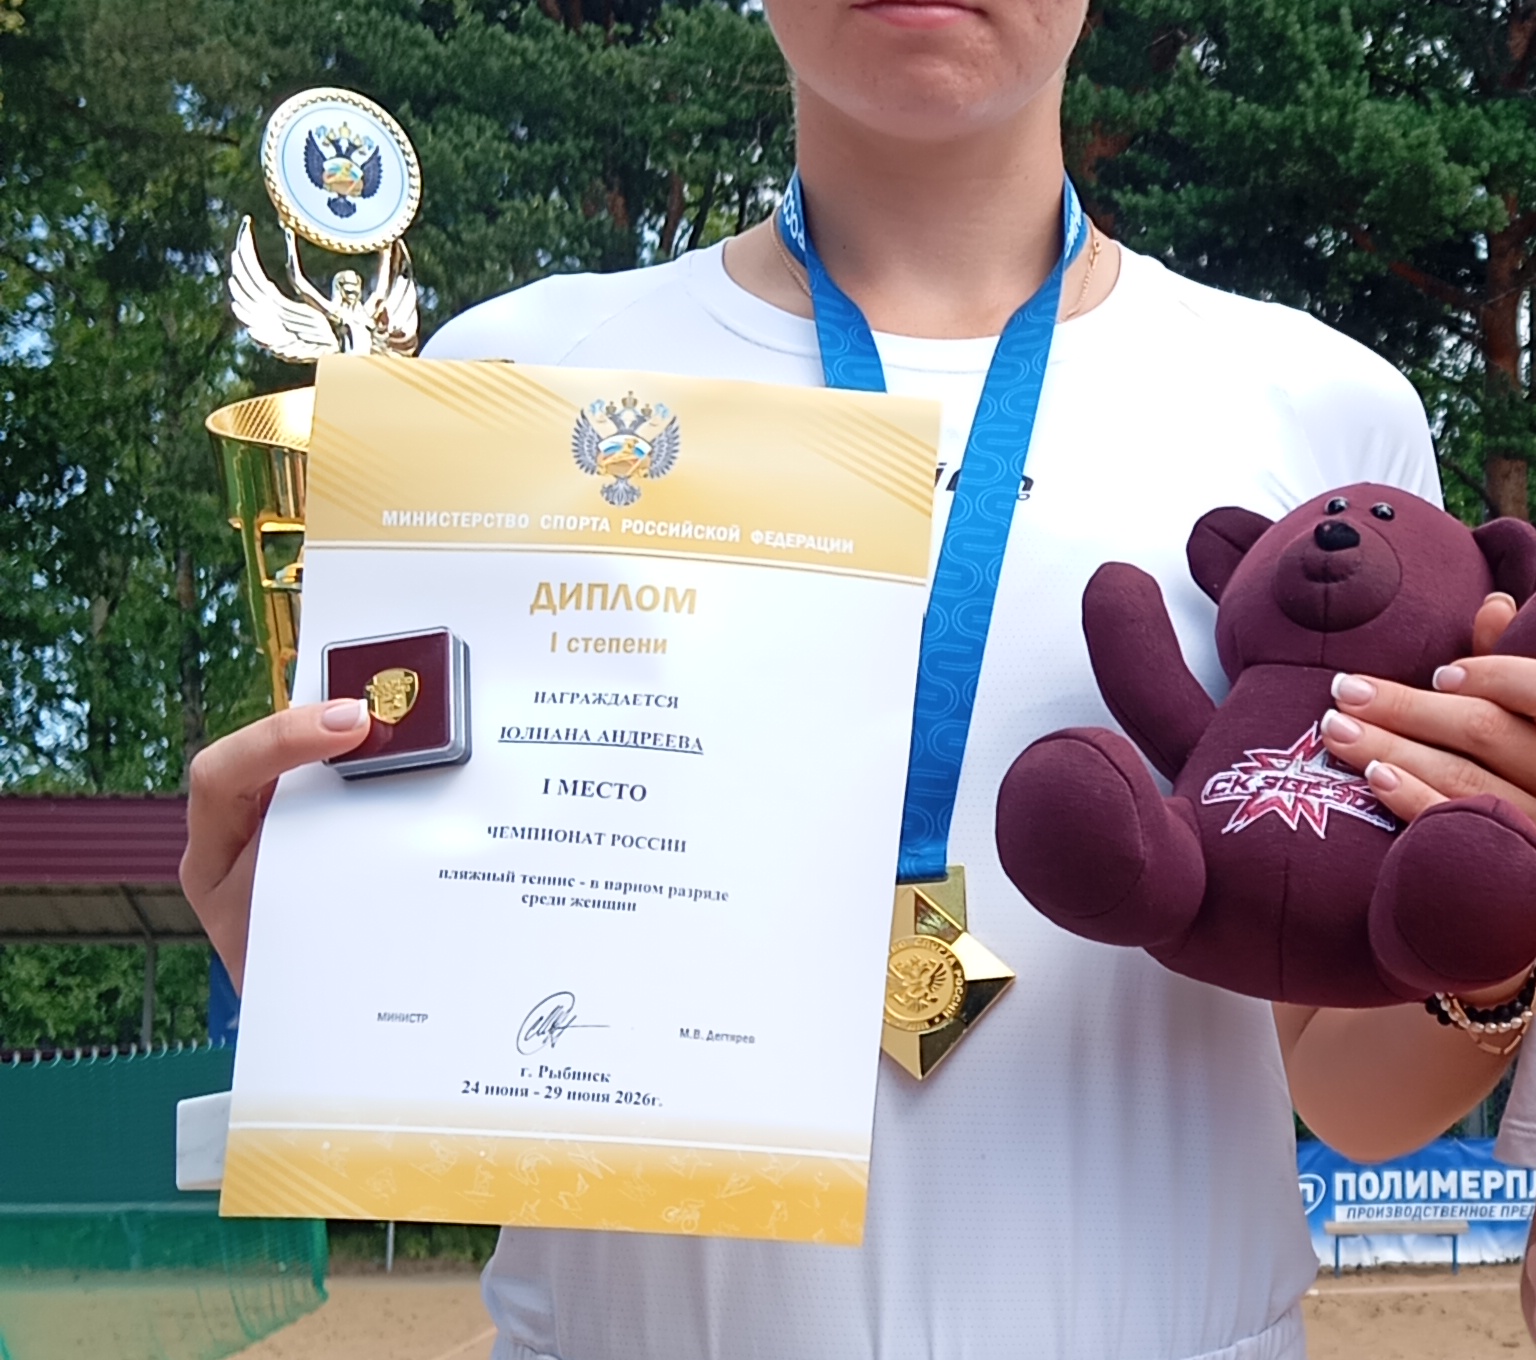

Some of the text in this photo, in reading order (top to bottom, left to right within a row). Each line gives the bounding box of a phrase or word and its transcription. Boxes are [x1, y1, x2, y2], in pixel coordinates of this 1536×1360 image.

[382, 509, 854, 554] МИНИСТЕРСТВО СПОРТА РОССИЙСКОЙ ФЕДЕРАЦИИ
[530, 581, 697, 616] ДИПЛОМ
[566, 636, 668, 654] степени
[533, 691, 679, 709] НАГРАЖДАЕТСЯ
[499, 726, 704, 752] ЮЛИАНА АНДРЕЕВА
[557, 778, 648, 802] МЕСТО
[487, 826, 687, 853] ЧЕМПИОНАТ РОССИИ
[438, 868, 516, 884] пляжный
[519, 873, 576, 888] теннис
[604, 879, 664, 896] парном
[667, 885, 729, 902] разряде
[521, 892, 637, 912] среди женщин
[538, 1064, 611, 1083] Рыбинск
[461, 1080, 480, 1095] 24
[484, 1084, 529, 1097] июня
[543, 1085, 562, 1100] 29
[567, 1090, 610, 1104] июня
[1347, 1204, 1496, 1221] ПРОИЗВОДСТВЕННОЕ
